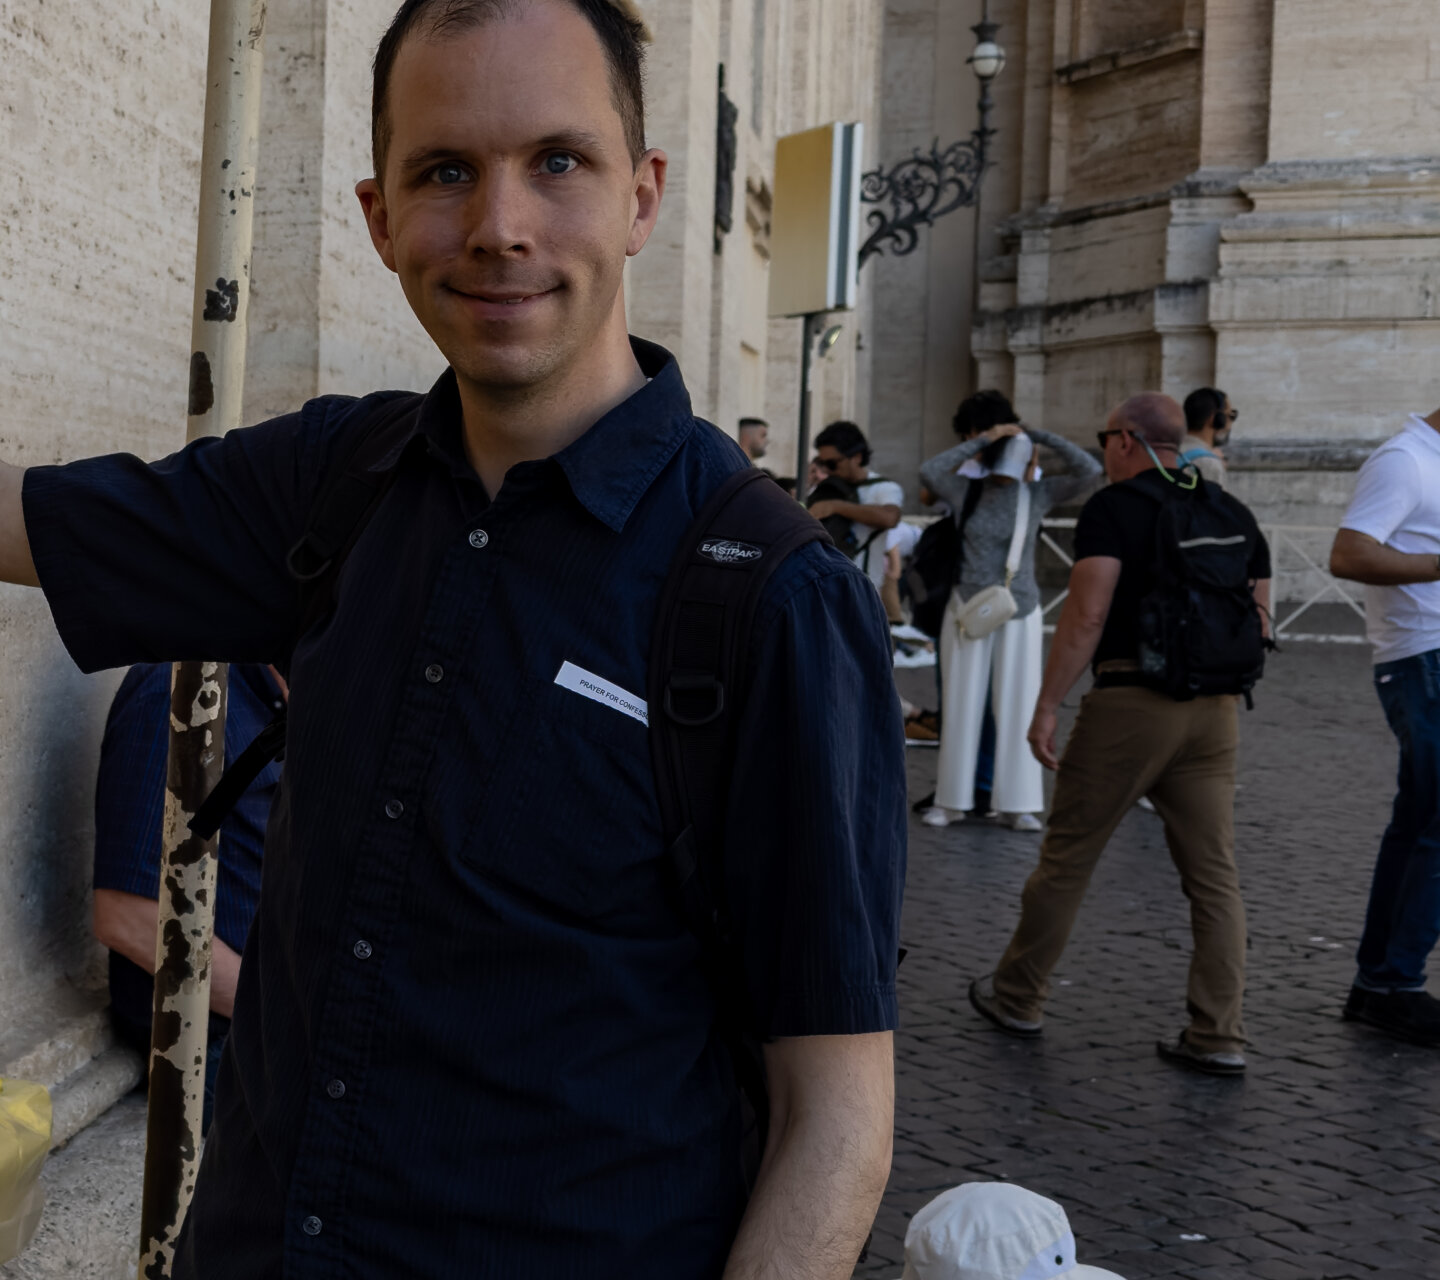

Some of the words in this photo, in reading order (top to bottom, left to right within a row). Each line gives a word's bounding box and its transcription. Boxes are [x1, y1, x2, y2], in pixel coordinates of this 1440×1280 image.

[701, 543, 756, 558] EASTPAK
[579, 679, 606, 696] PRAYER
[605, 692, 620, 704] FOR
